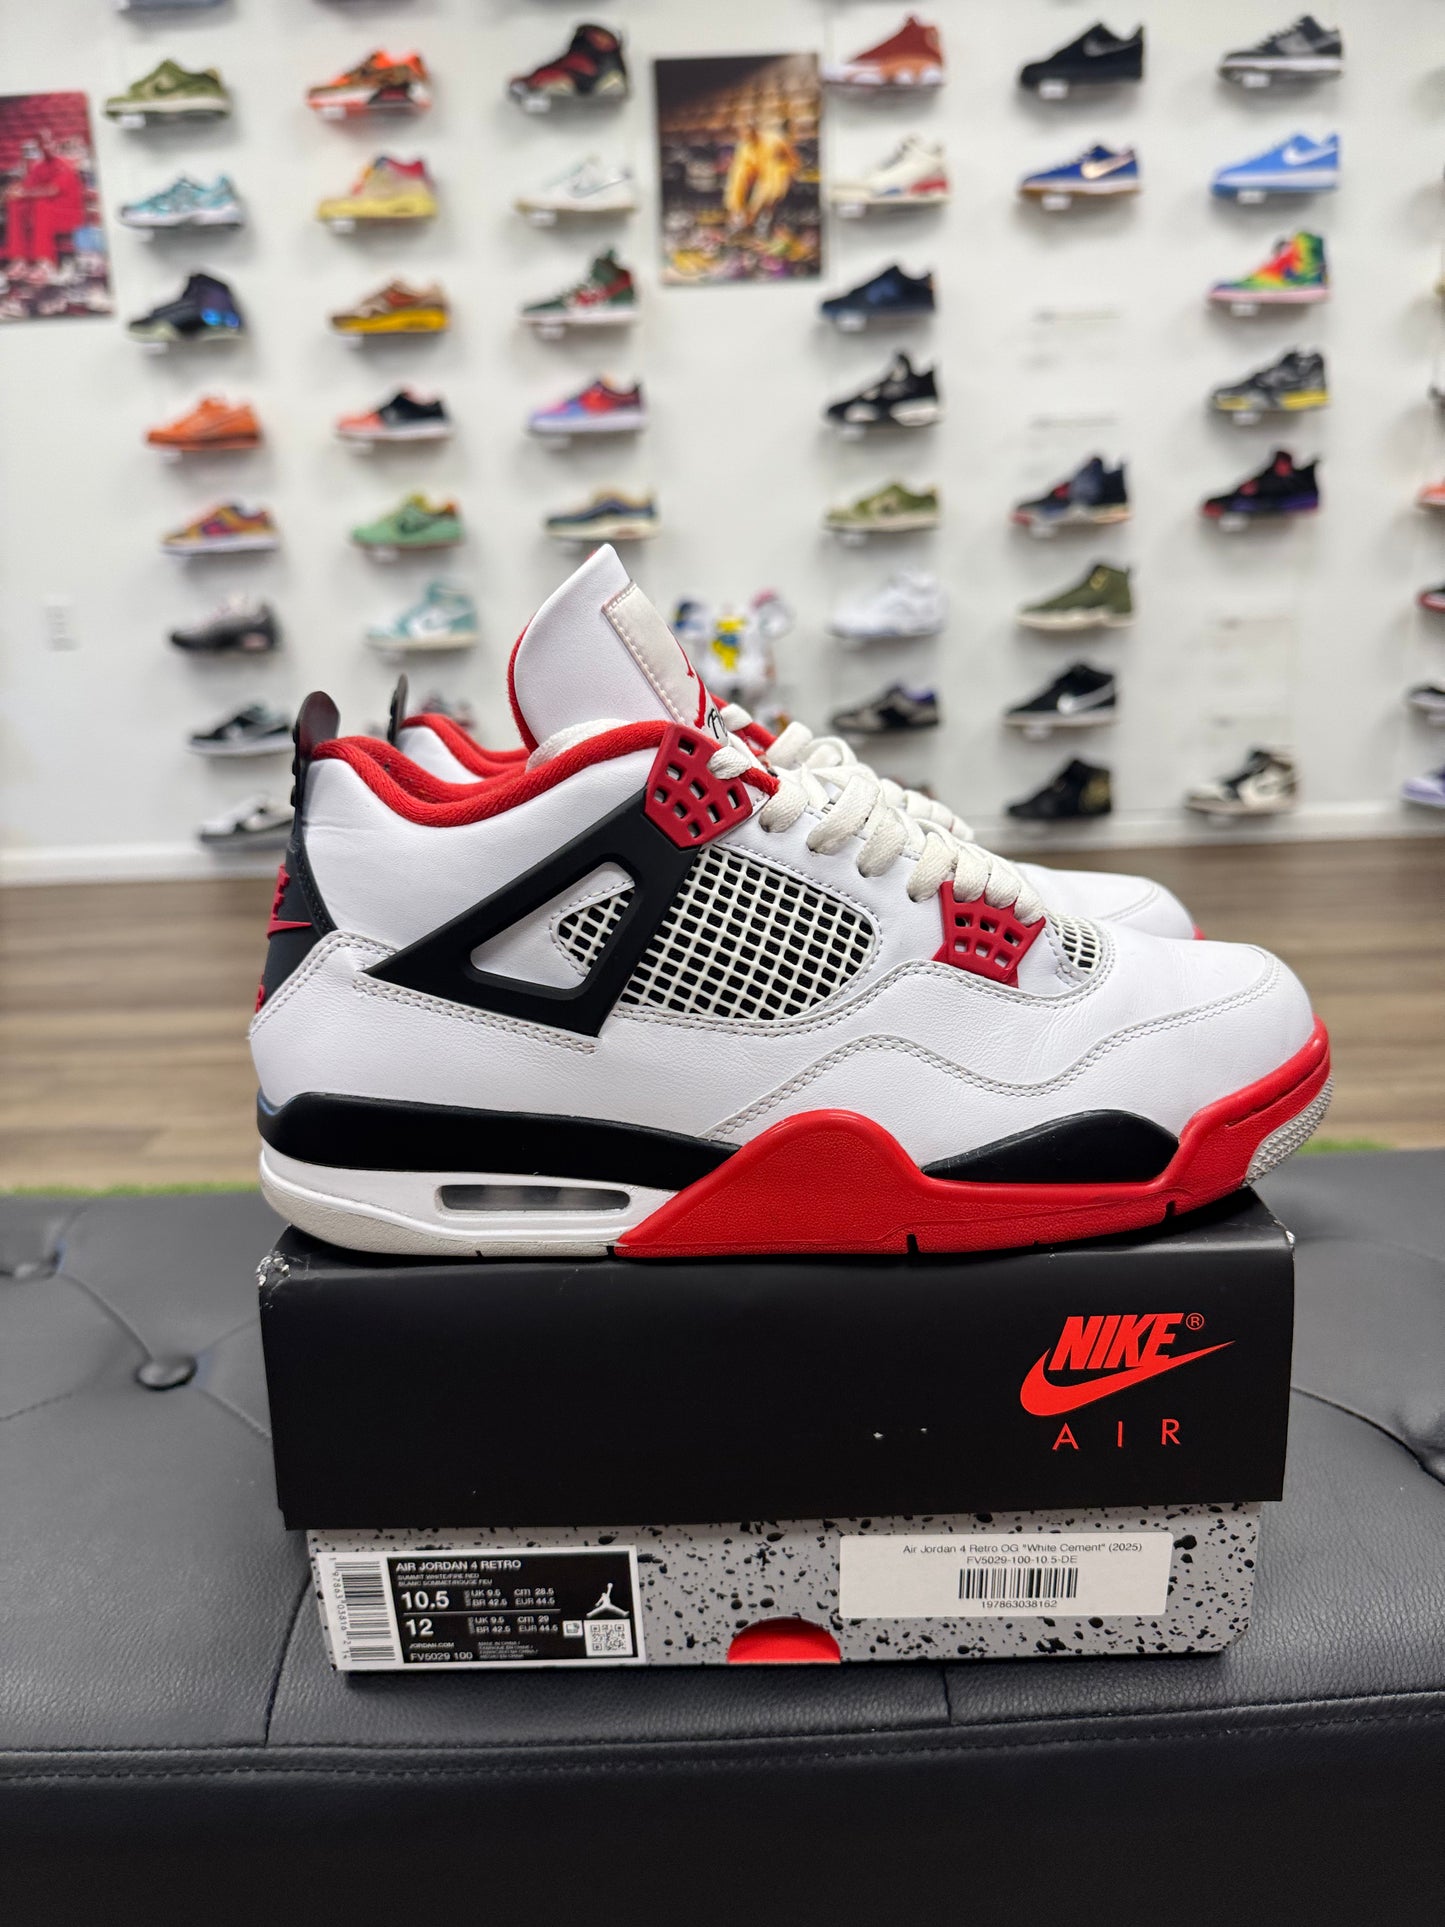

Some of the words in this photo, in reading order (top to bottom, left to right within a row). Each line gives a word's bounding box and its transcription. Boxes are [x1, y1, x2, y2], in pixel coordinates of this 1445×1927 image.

[1048, 1313, 1185, 1371] NIKE
[1052, 1418, 1181, 1452] AIR
[903, 1545, 920, 1553] Air
[921, 1544, 957, 1553] Jordan
[969, 1544, 998, 1552] Retro
[1000, 1544, 1019, 1552] OG
[1022, 1543, 1057, 1552] "White
[1059, 1543, 1106, 1552] Cement"
[1108, 1543, 1143, 1553] (2025)
[966, 1555, 1078, 1564] FV5029-100-10.5-DE
[396, 1562, 416, 1572] AIR
[419, 1561, 468, 1571] JORDAN
[470, 1561, 478, 1570] 4
[480, 1560, 522, 1570] RETRO
[471, 1589, 485, 1597] UK
[487, 1589, 501, 1597] 9.5
[515, 1588, 531, 1597] cm
[535, 1587, 555, 1596] 28.5
[401, 1590, 450, 1609] 10.5
[472, 1598, 486, 1606] BR
[488, 1598, 508, 1606] 42.5
[515, 1597, 534, 1607] EUR
[536, 1597, 556, 1606] 44.5
[981, 1600, 1058, 1609] 197863038162
[475, 1616, 489, 1624] UK
[490, 1616, 505, 1624] 9.5
[518, 1616, 534, 1624] cm
[538, 1615, 550, 1623] 29
[405, 1617, 434, 1637] 12
[476, 1625, 490, 1633] BR
[492, 1625, 511, 1633] 42.5
[519, 1624, 537, 1634] EUR
[539, 1624, 558, 1633] 44.5
[410, 1652, 451, 1661] FV5029
[454, 1651, 473, 1660] 100
